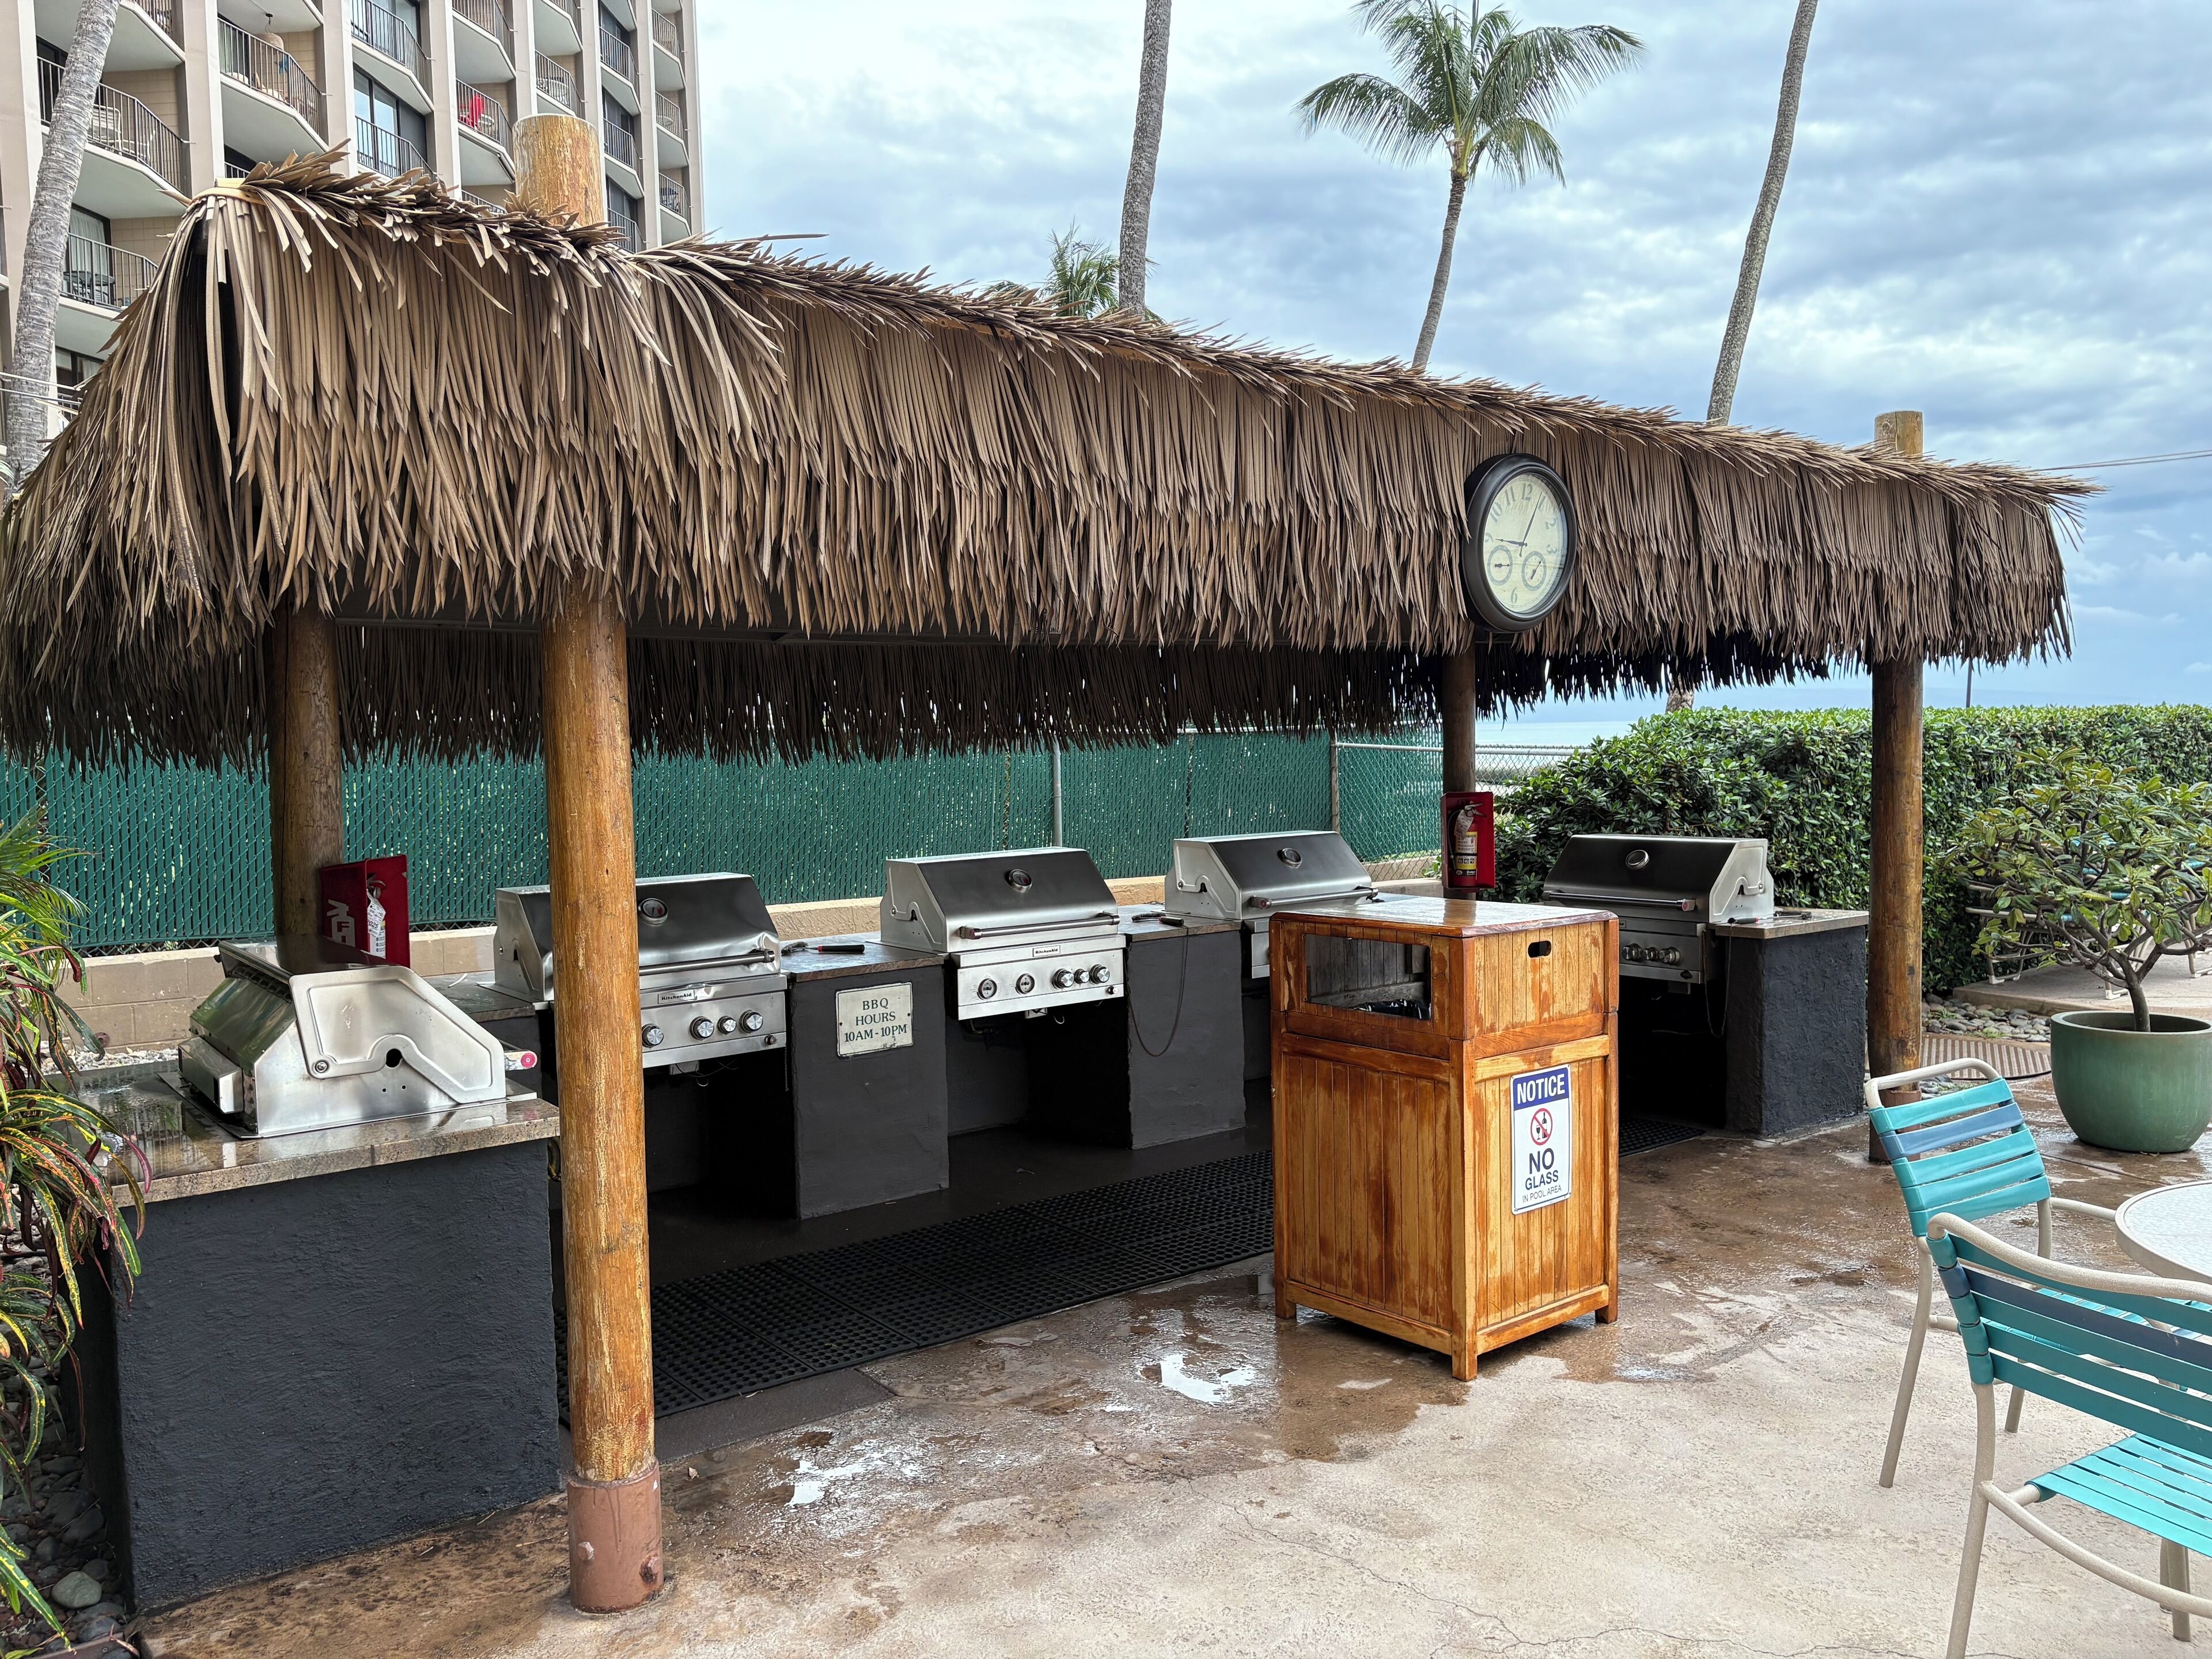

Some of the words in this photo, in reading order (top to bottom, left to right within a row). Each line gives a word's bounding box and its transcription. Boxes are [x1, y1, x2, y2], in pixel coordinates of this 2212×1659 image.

[1504, 486, 1516, 506] 11
[1521, 483, 1533, 501] 12
[1490, 502, 1502, 524] 10
[1545, 517, 1556, 529] 2
[1546, 544, 1558, 554] 3
[1510, 586, 1518, 604] 6
[661, 993, 692, 1001] KitchenAid
[862, 998, 889, 1010] BBQ
[855, 1012, 896, 1026] HOURS
[1517, 1073, 1566, 1104] NOTICE
[1529, 1147, 1555, 1175] NO
[1525, 1169, 1559, 1191] GLASS
[1522, 1194, 1528, 1203] IN
[1530, 1190, 1546, 1200] POOL
[1547, 1184, 1562, 1195] AREA
